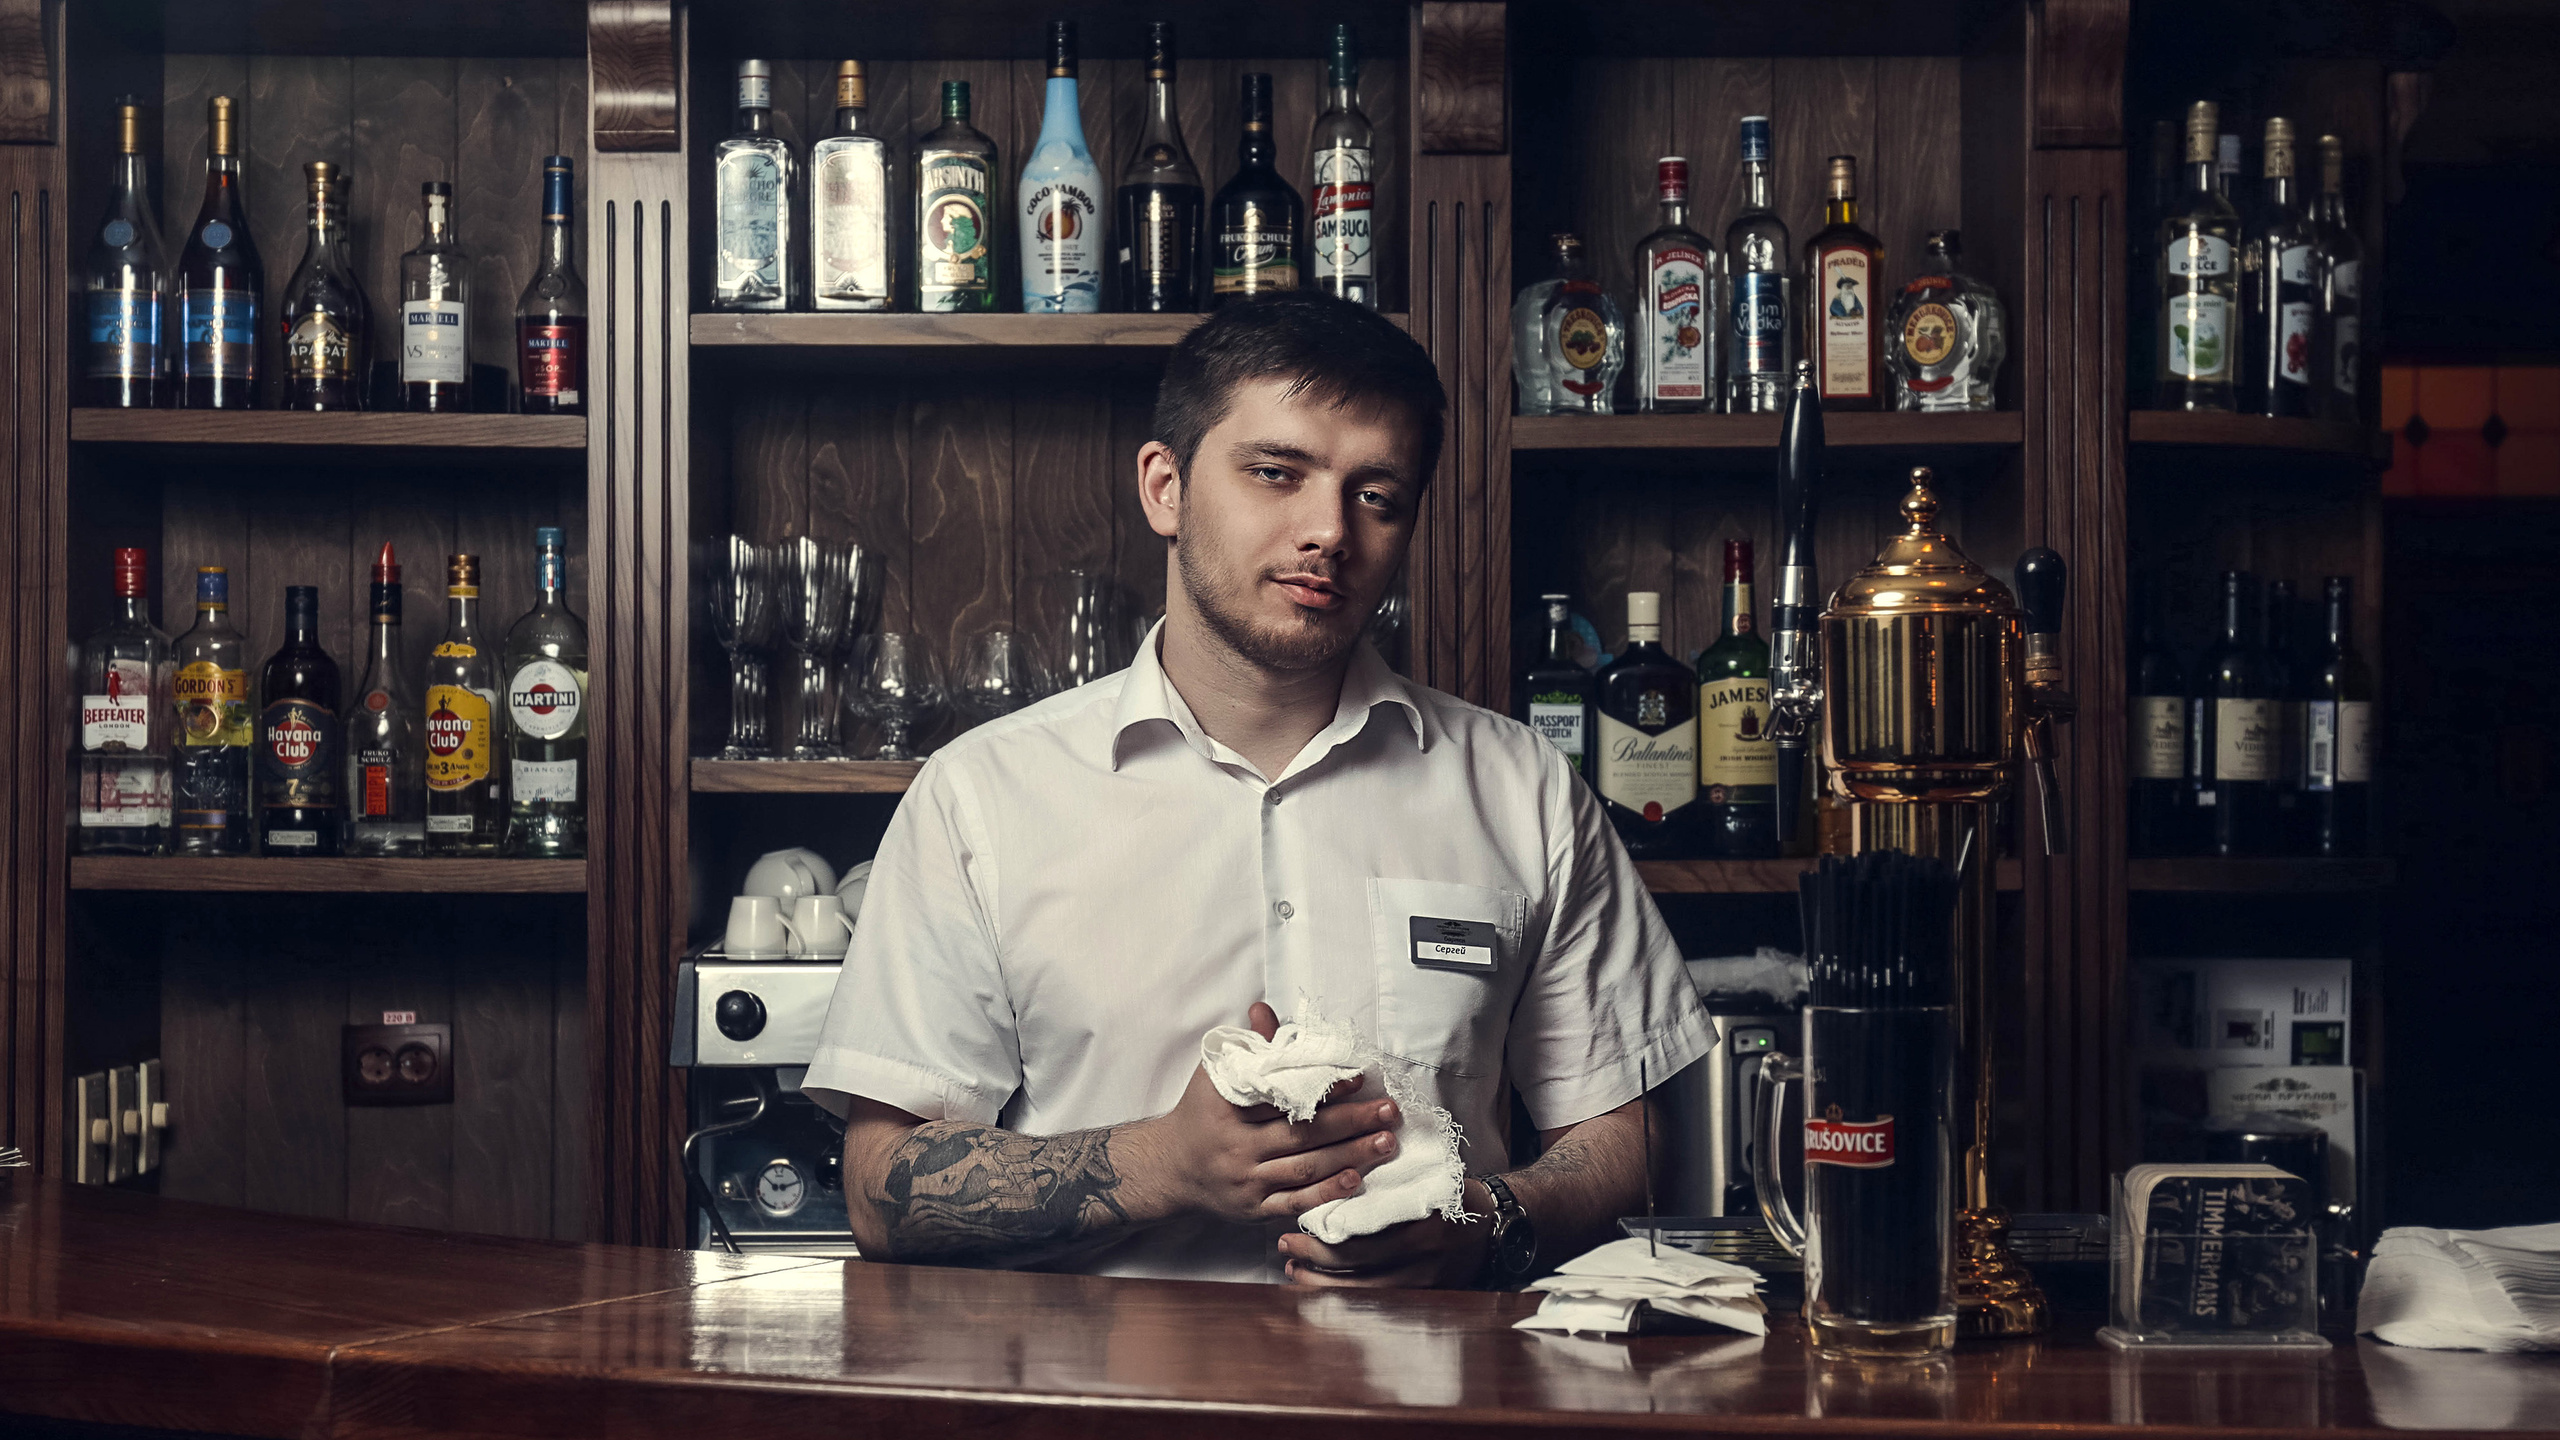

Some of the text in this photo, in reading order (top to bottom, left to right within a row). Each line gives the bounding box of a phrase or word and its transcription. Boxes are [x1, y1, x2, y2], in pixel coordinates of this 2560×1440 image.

[921, 165, 985, 197] ABSINTH
[2180, 260, 2217, 271] DLCE
[1740, 302, 1780, 316] Pum
[528, 339, 568, 348] MARTELL
[406, 344, 423, 359] VS
[175, 676, 235, 695] GORDON'S
[514, 692, 575, 706] MARTINI
[1710, 687, 1770, 709] JAMES
[84, 708, 146, 725] BEEFEATER
[427, 717, 472, 731] avana
[1534, 714, 1580, 727] PASSPORT
[267, 726, 322, 742] Havana
[430, 732, 459, 748] Club
[1542, 728, 1572, 738] SCOTCH
[276, 741, 310, 758] Club
[1610, 735, 1694, 763] Ballantine's
[440, 761, 449, 775] 3
[286, 778, 300, 796] 7
[1435, 944, 1466, 955] Сергей
[386, 1013, 403, 1023] 220
[2196, 1187, 2229, 1320] TIMMERMANS
